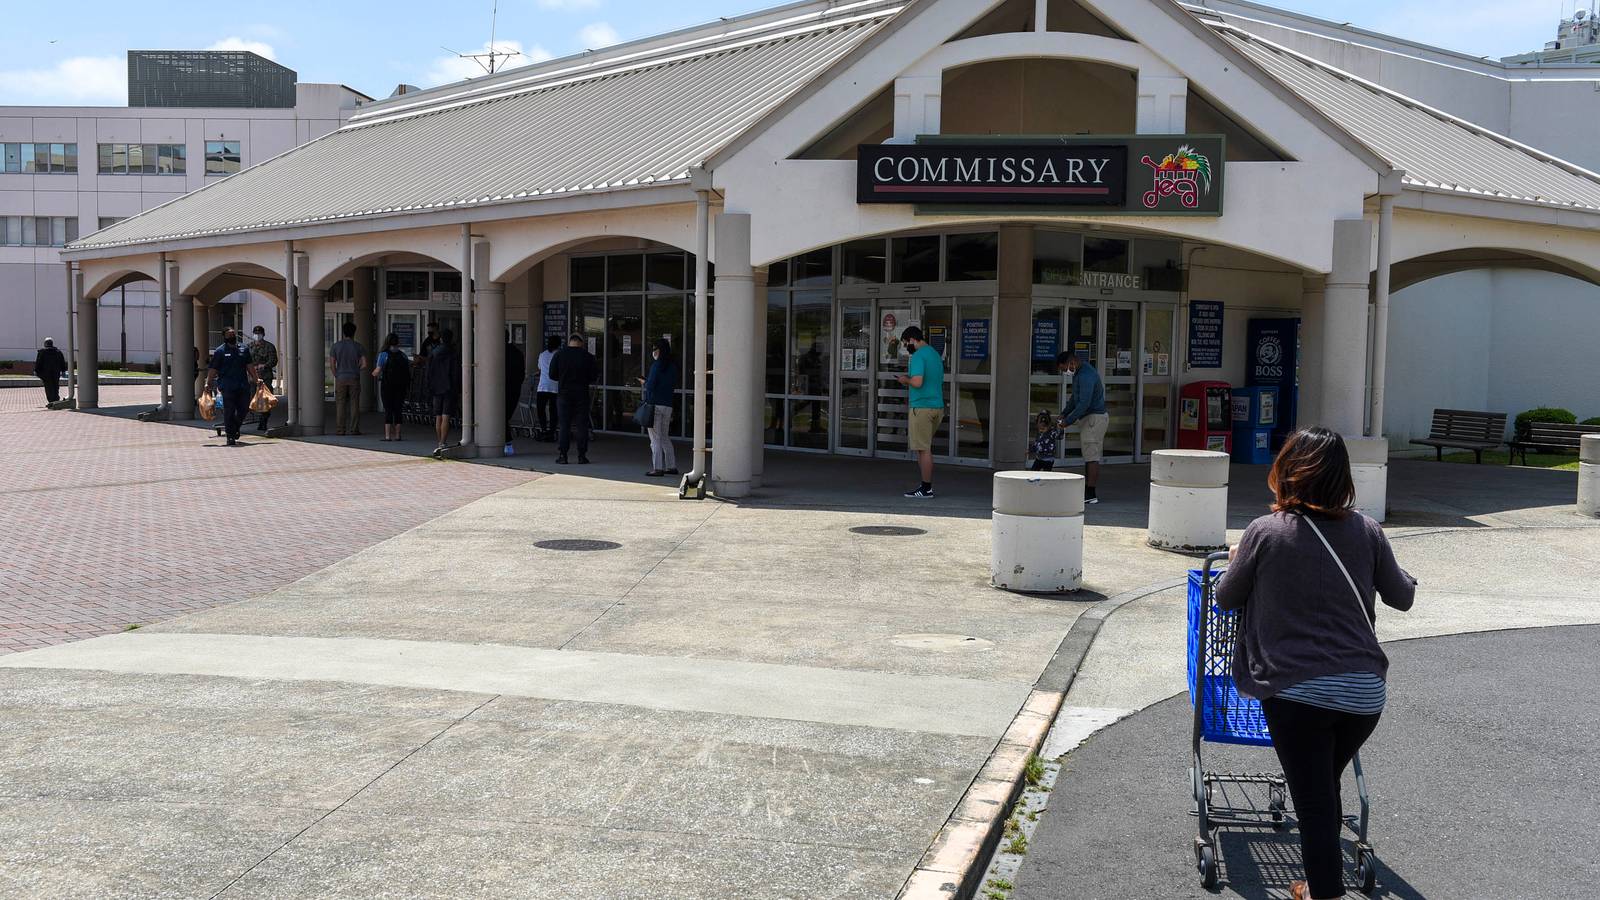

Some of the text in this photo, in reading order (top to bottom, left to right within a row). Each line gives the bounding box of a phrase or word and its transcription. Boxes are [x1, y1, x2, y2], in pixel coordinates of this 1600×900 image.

[873, 155, 1111, 184] COMMISSARY
[1258, 336, 1281, 345] COFFEE
[1255, 365, 1283, 377] BOSS
[1231, 404, 1247, 412] APAN
